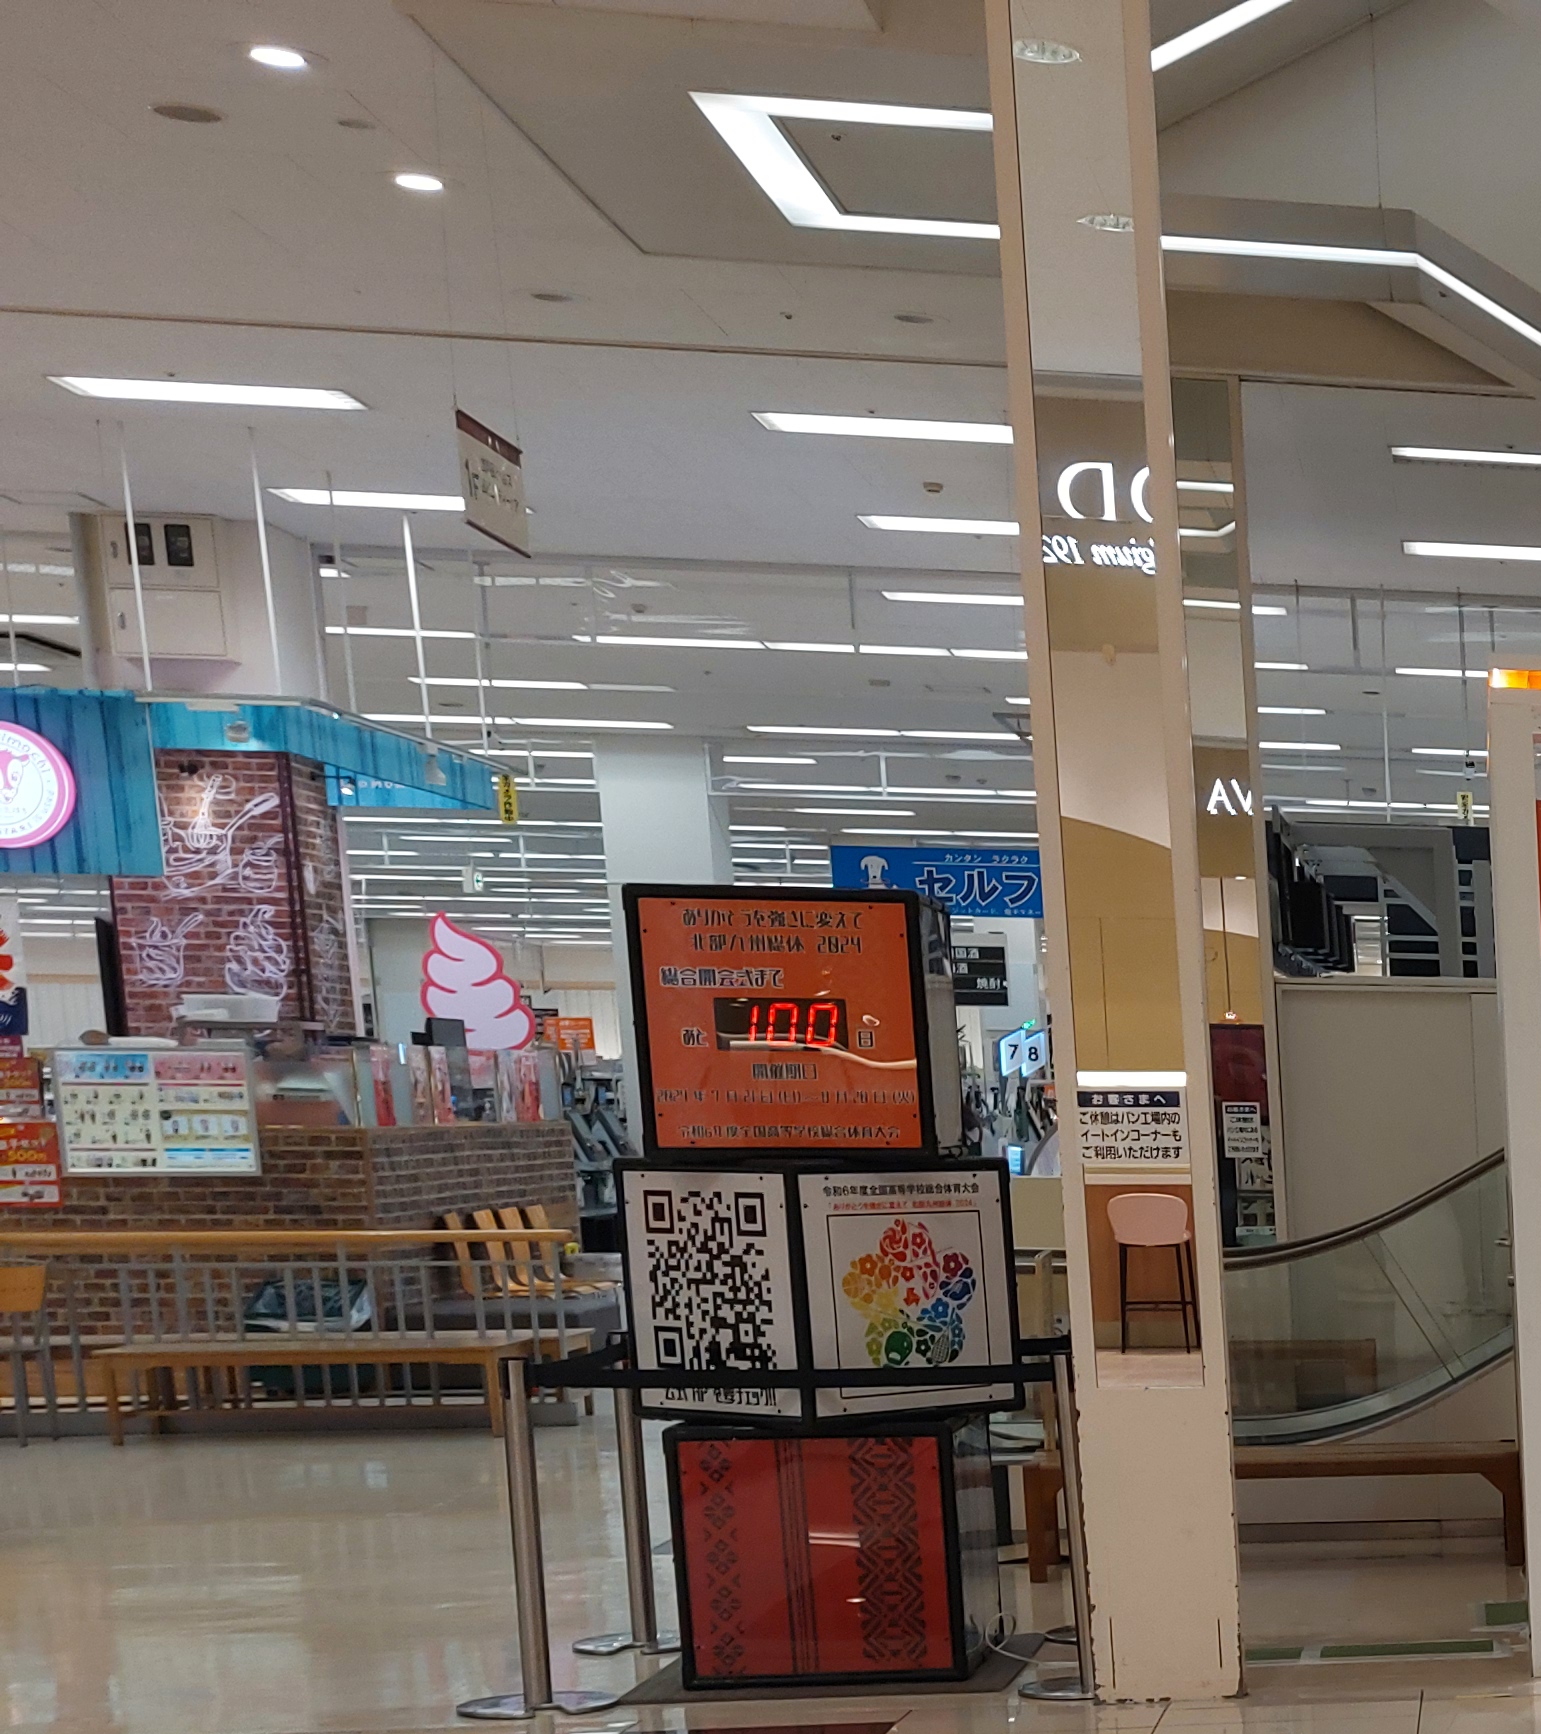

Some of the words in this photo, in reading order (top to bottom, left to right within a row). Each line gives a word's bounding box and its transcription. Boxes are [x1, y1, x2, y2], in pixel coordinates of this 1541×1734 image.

[916, 867, 1039, 908] セルフ
[816, 935, 863, 954] 2024
[748, 1002, 839, 1047] 100
[856, 1029, 876, 1049] 日
[1007, 1043, 1020, 1060] 7
[1027, 1046, 1039, 1062] 8
[1091, 1093, 1167, 1106] お客さまへ
[1080, 1127, 1183, 1143] イートインコーナーも
[1082, 1145, 1183, 1161] ご利用いただけます
